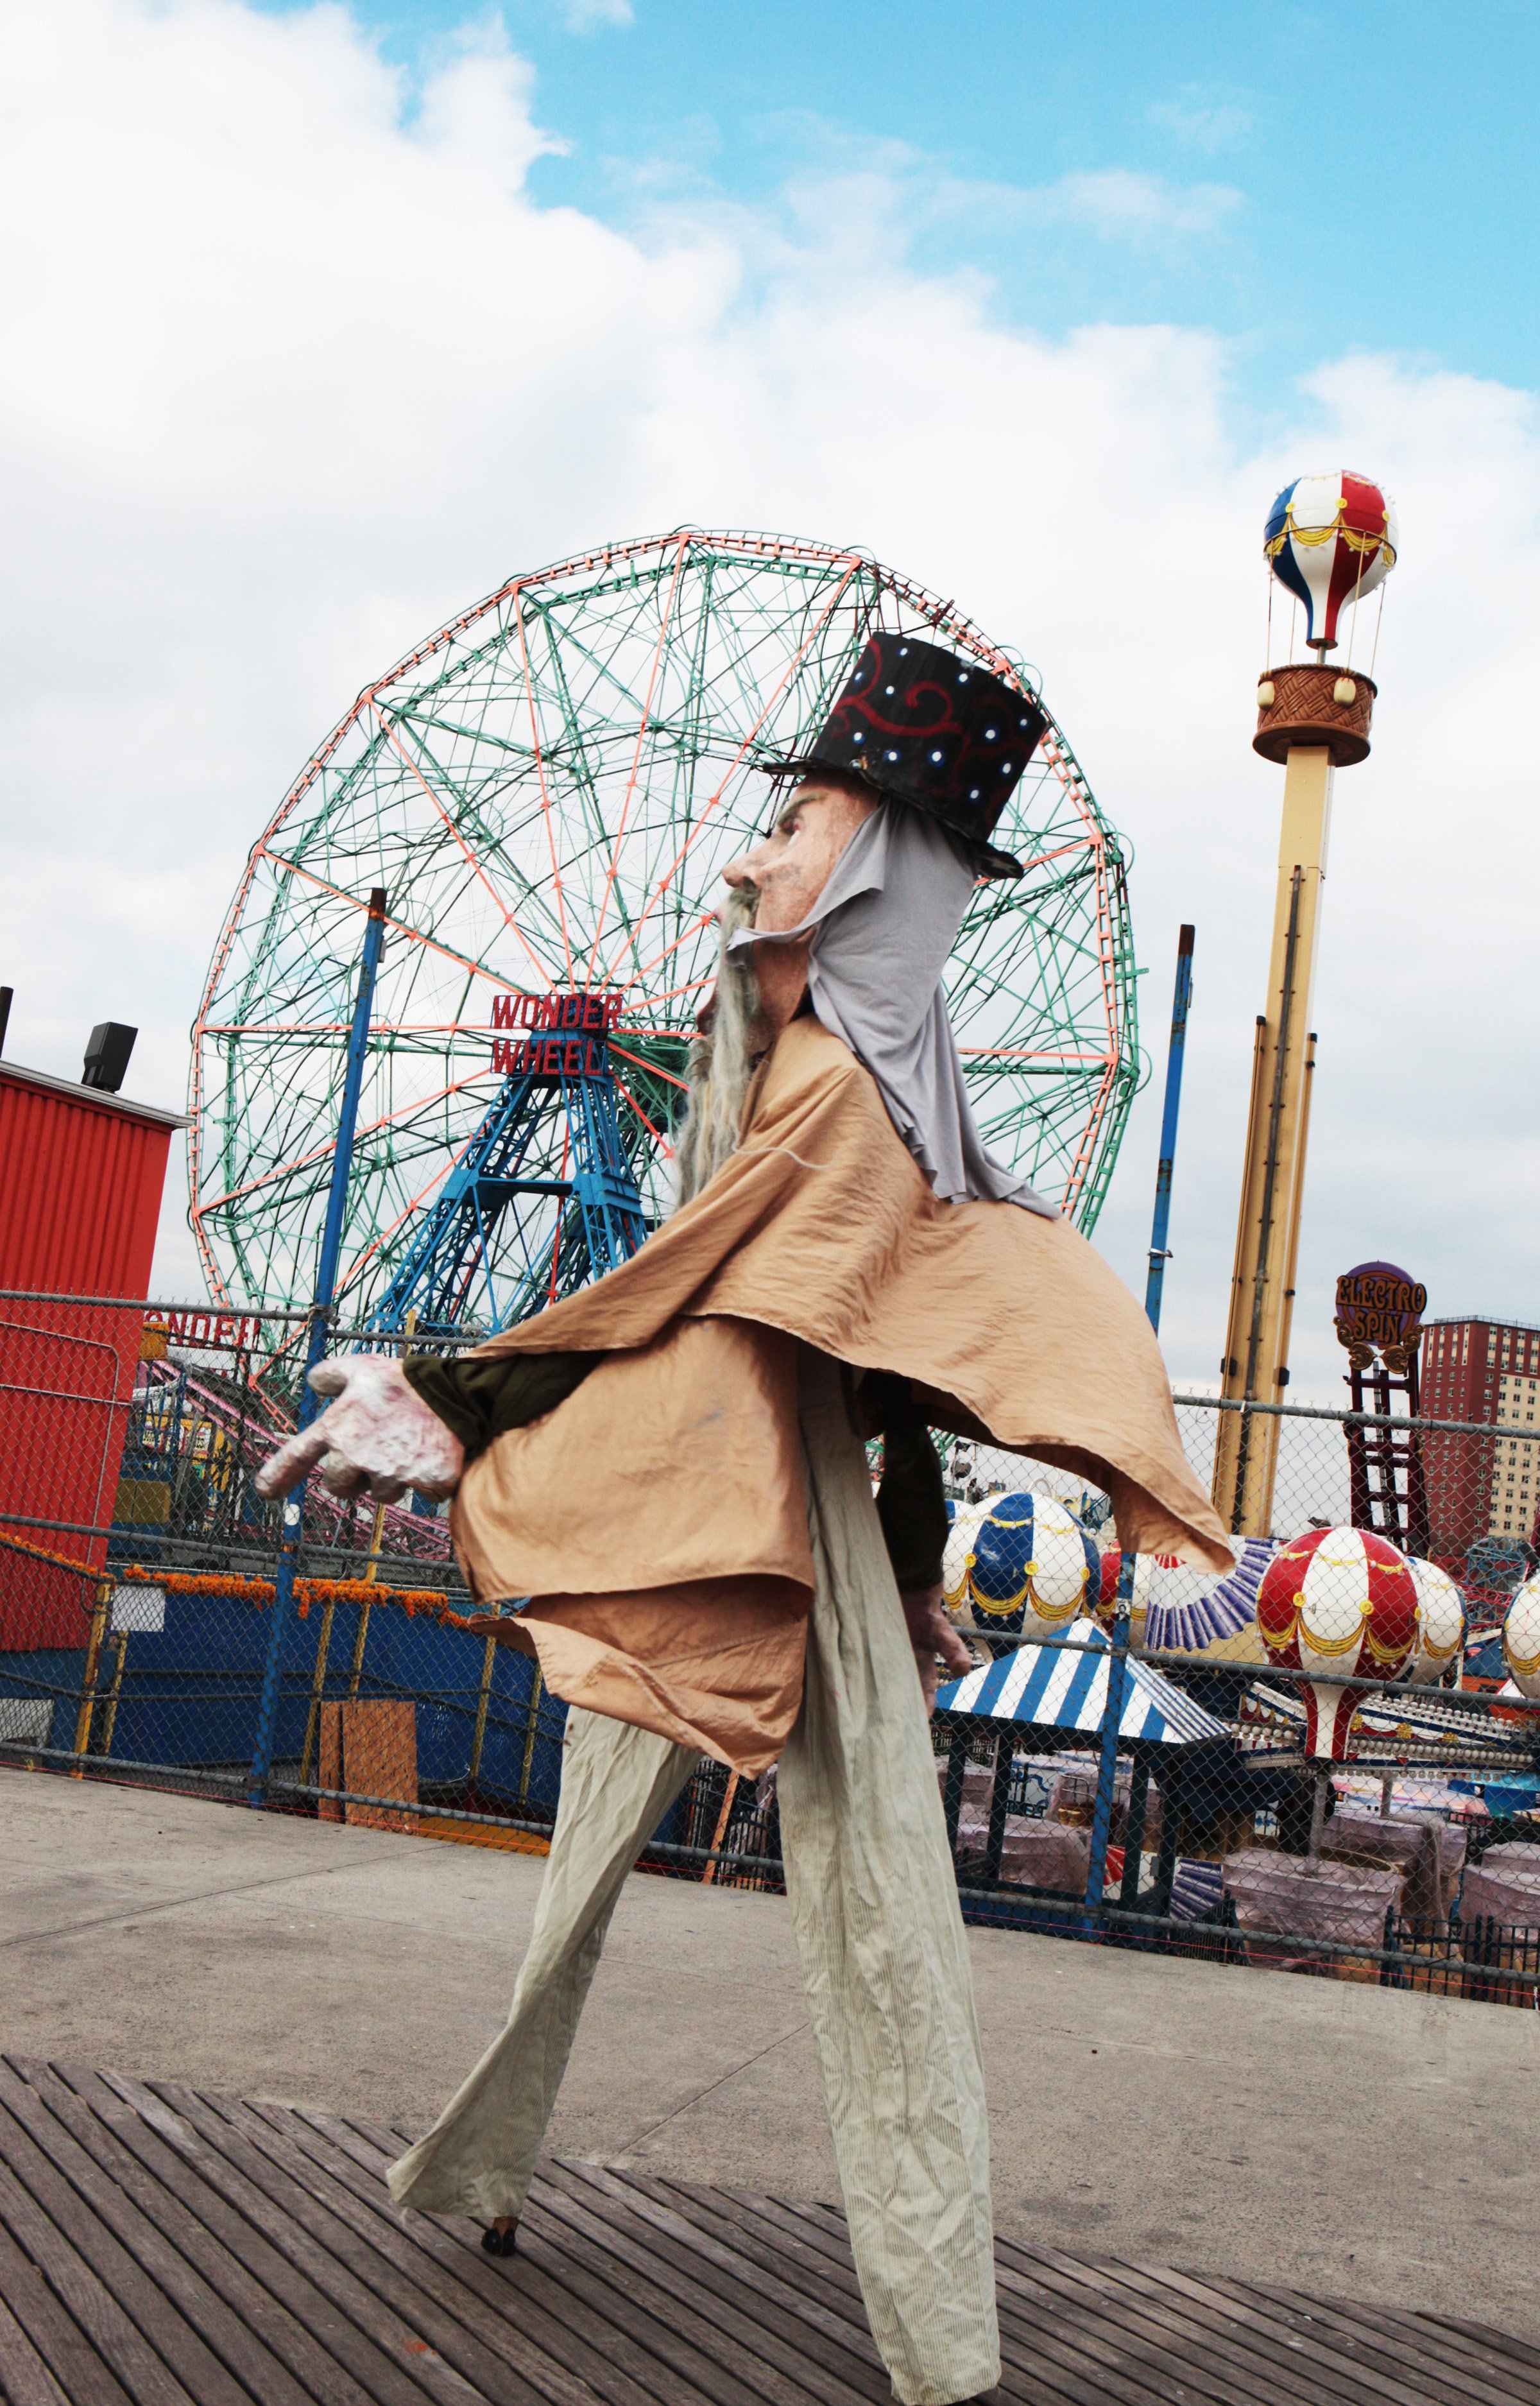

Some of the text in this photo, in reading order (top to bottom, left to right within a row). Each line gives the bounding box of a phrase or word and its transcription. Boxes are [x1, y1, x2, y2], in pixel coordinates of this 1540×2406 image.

[493, 995, 622, 1029] WONDER
[493, 1039, 601, 1075] WHEEL
[1336, 1276, 1426, 1312] ELECTRO
[1354, 1312, 1400, 1343] SPIN
